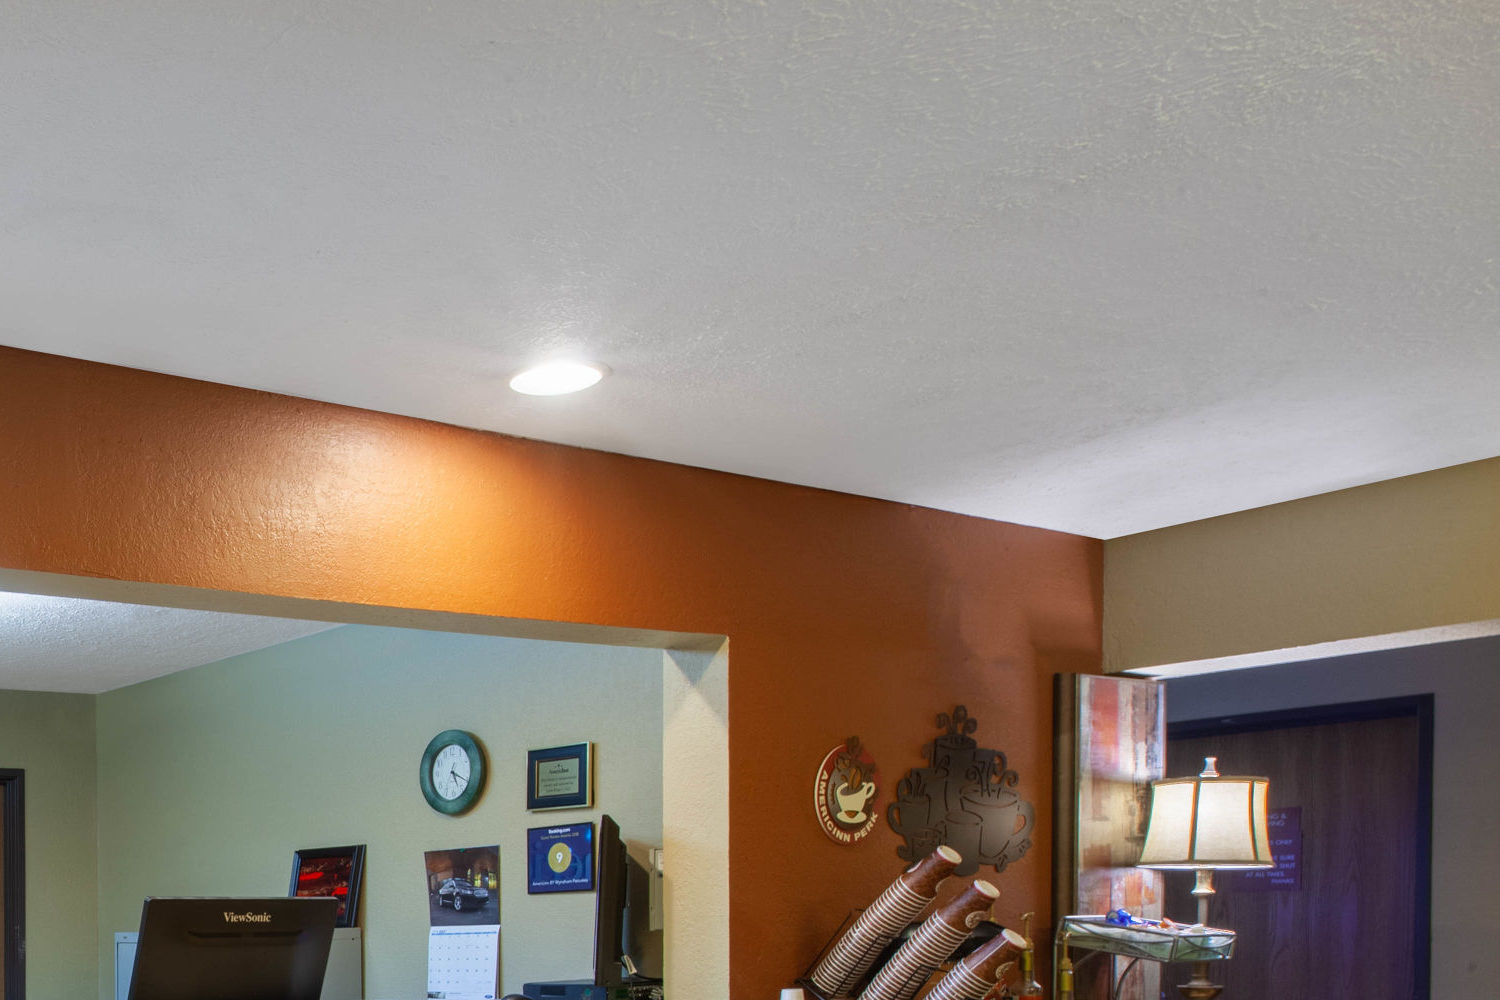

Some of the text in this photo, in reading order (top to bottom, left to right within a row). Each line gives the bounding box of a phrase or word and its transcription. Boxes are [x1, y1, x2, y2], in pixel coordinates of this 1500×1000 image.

[819, 769, 878, 843] AMERICINN PERK
[556, 852, 563, 864] 9
[223, 911, 272, 923] ViewSonic
